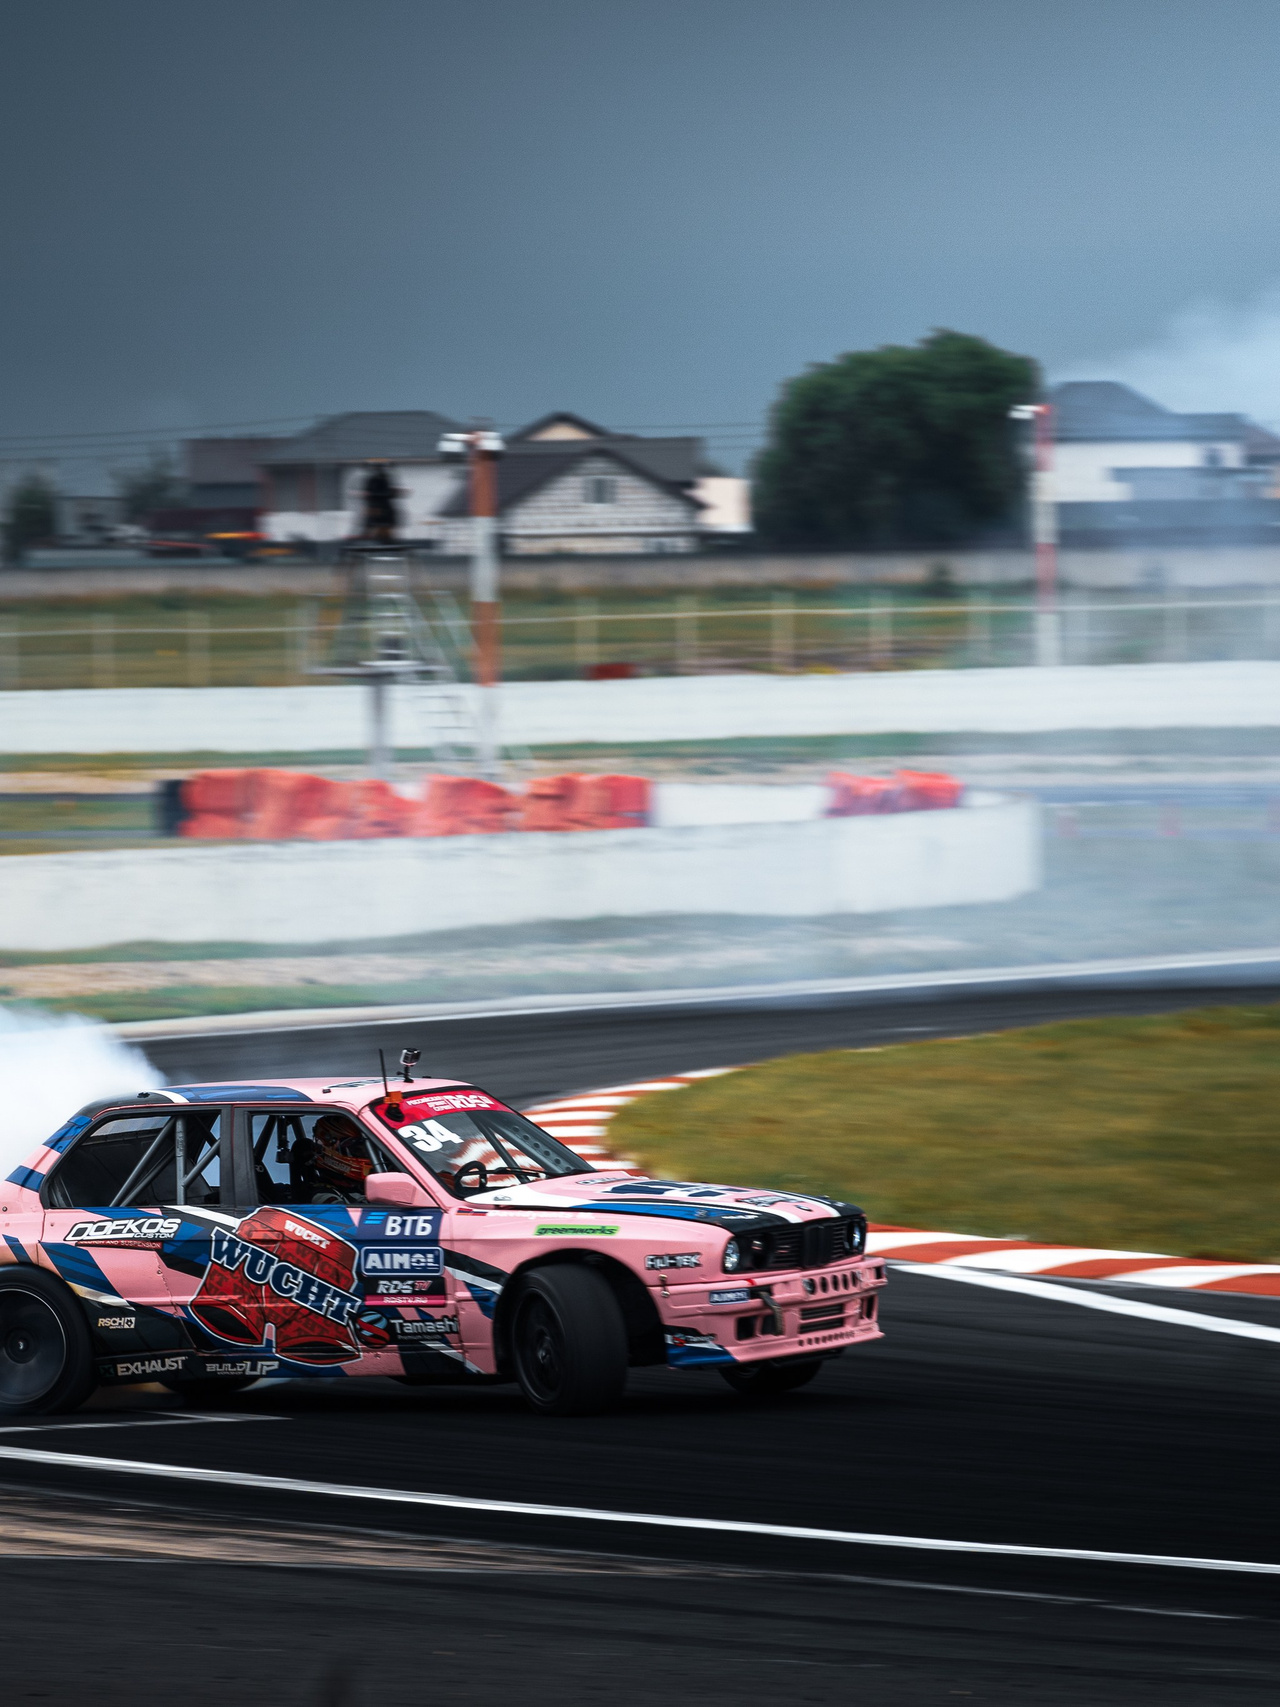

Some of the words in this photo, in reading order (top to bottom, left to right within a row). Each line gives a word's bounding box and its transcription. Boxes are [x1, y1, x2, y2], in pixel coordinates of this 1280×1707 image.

[398, 1120, 464, 1152] 34
[283, 1220, 330, 1249] WUCHT
[384, 1216, 434, 1236] ВТБ
[536, 1226, 616, 1235] greenworks
[365, 1253, 440, 1269] AIMOL
[210, 1226, 362, 1326] WUCHT
[98, 1317, 124, 1327] RSCH
[389, 1315, 459, 1333] Tamashi
[116, 1356, 186, 1376] EXHAUST
